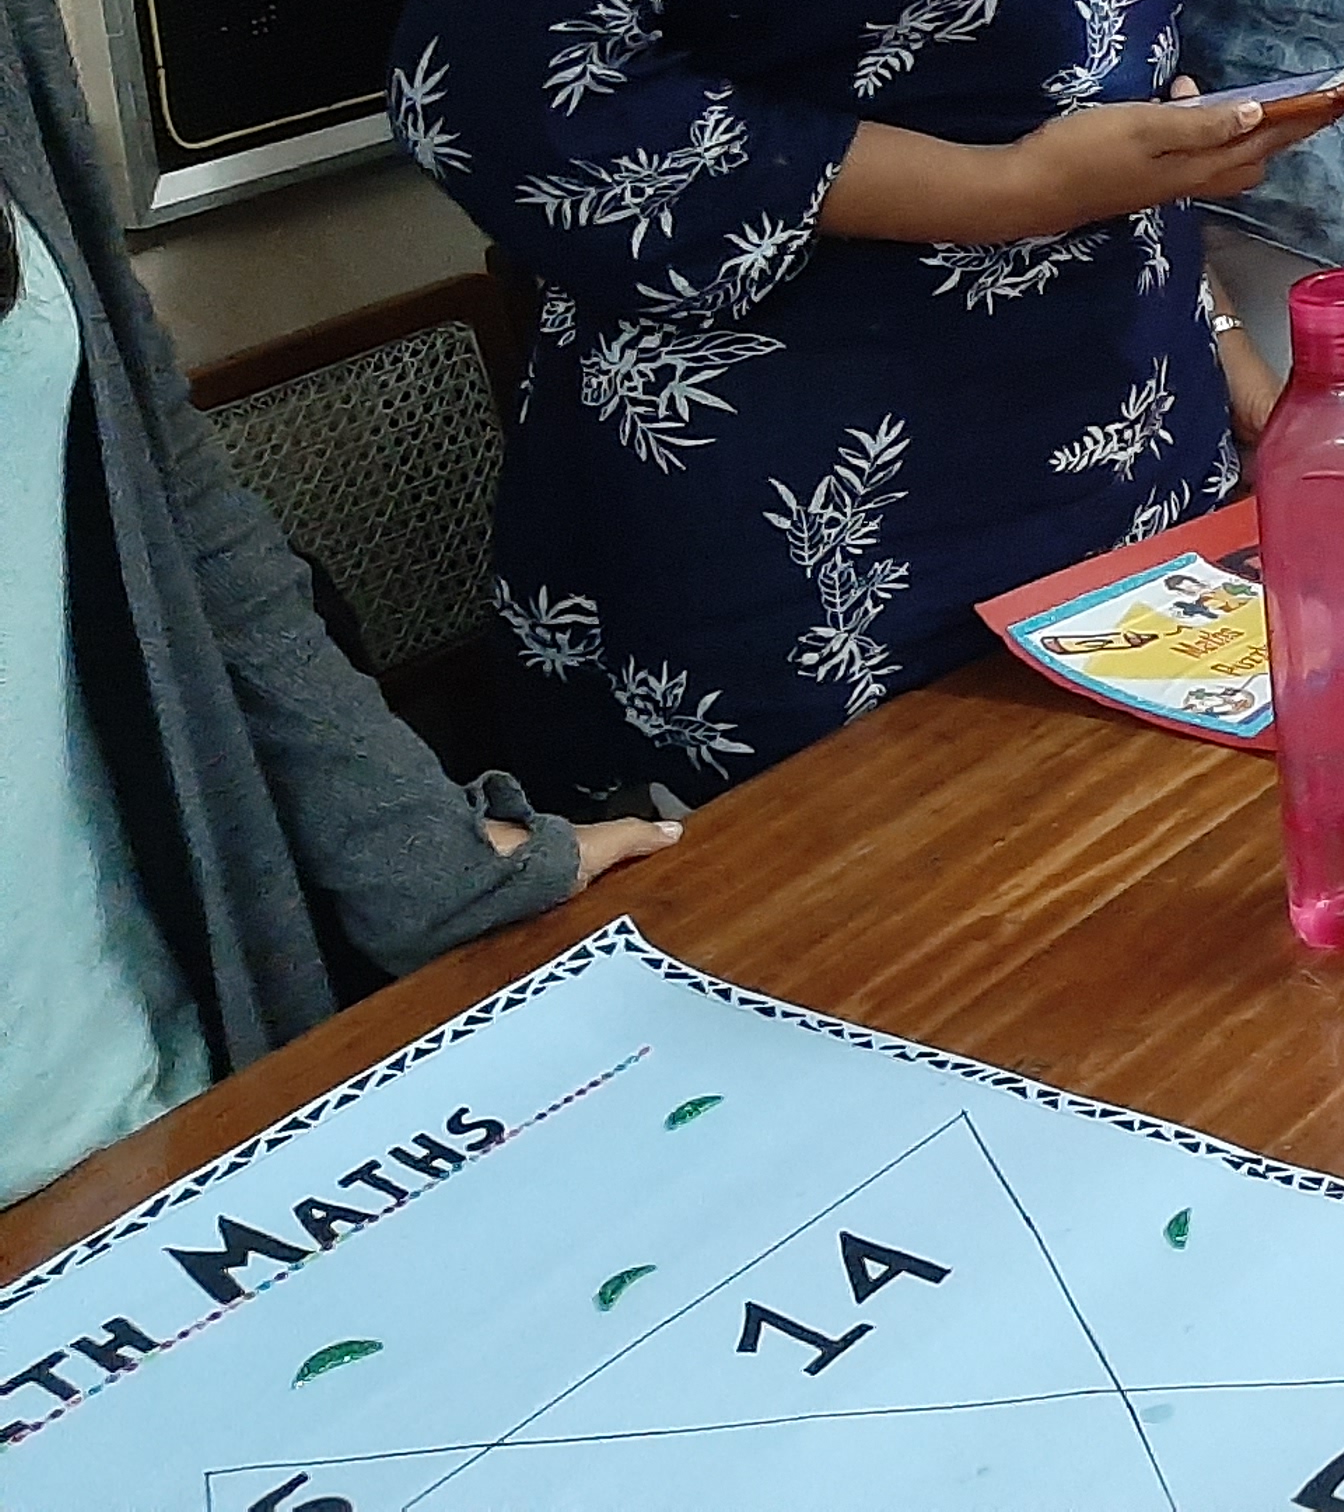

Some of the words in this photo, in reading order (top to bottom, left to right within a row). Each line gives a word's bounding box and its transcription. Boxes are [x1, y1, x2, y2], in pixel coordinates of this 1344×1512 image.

[1169, 627, 1245, 659] Maths
[0, 1317, 161, 1445] TH
[165, 1106, 507, 1306] MATHS
[736, 1231, 952, 1377] 14
